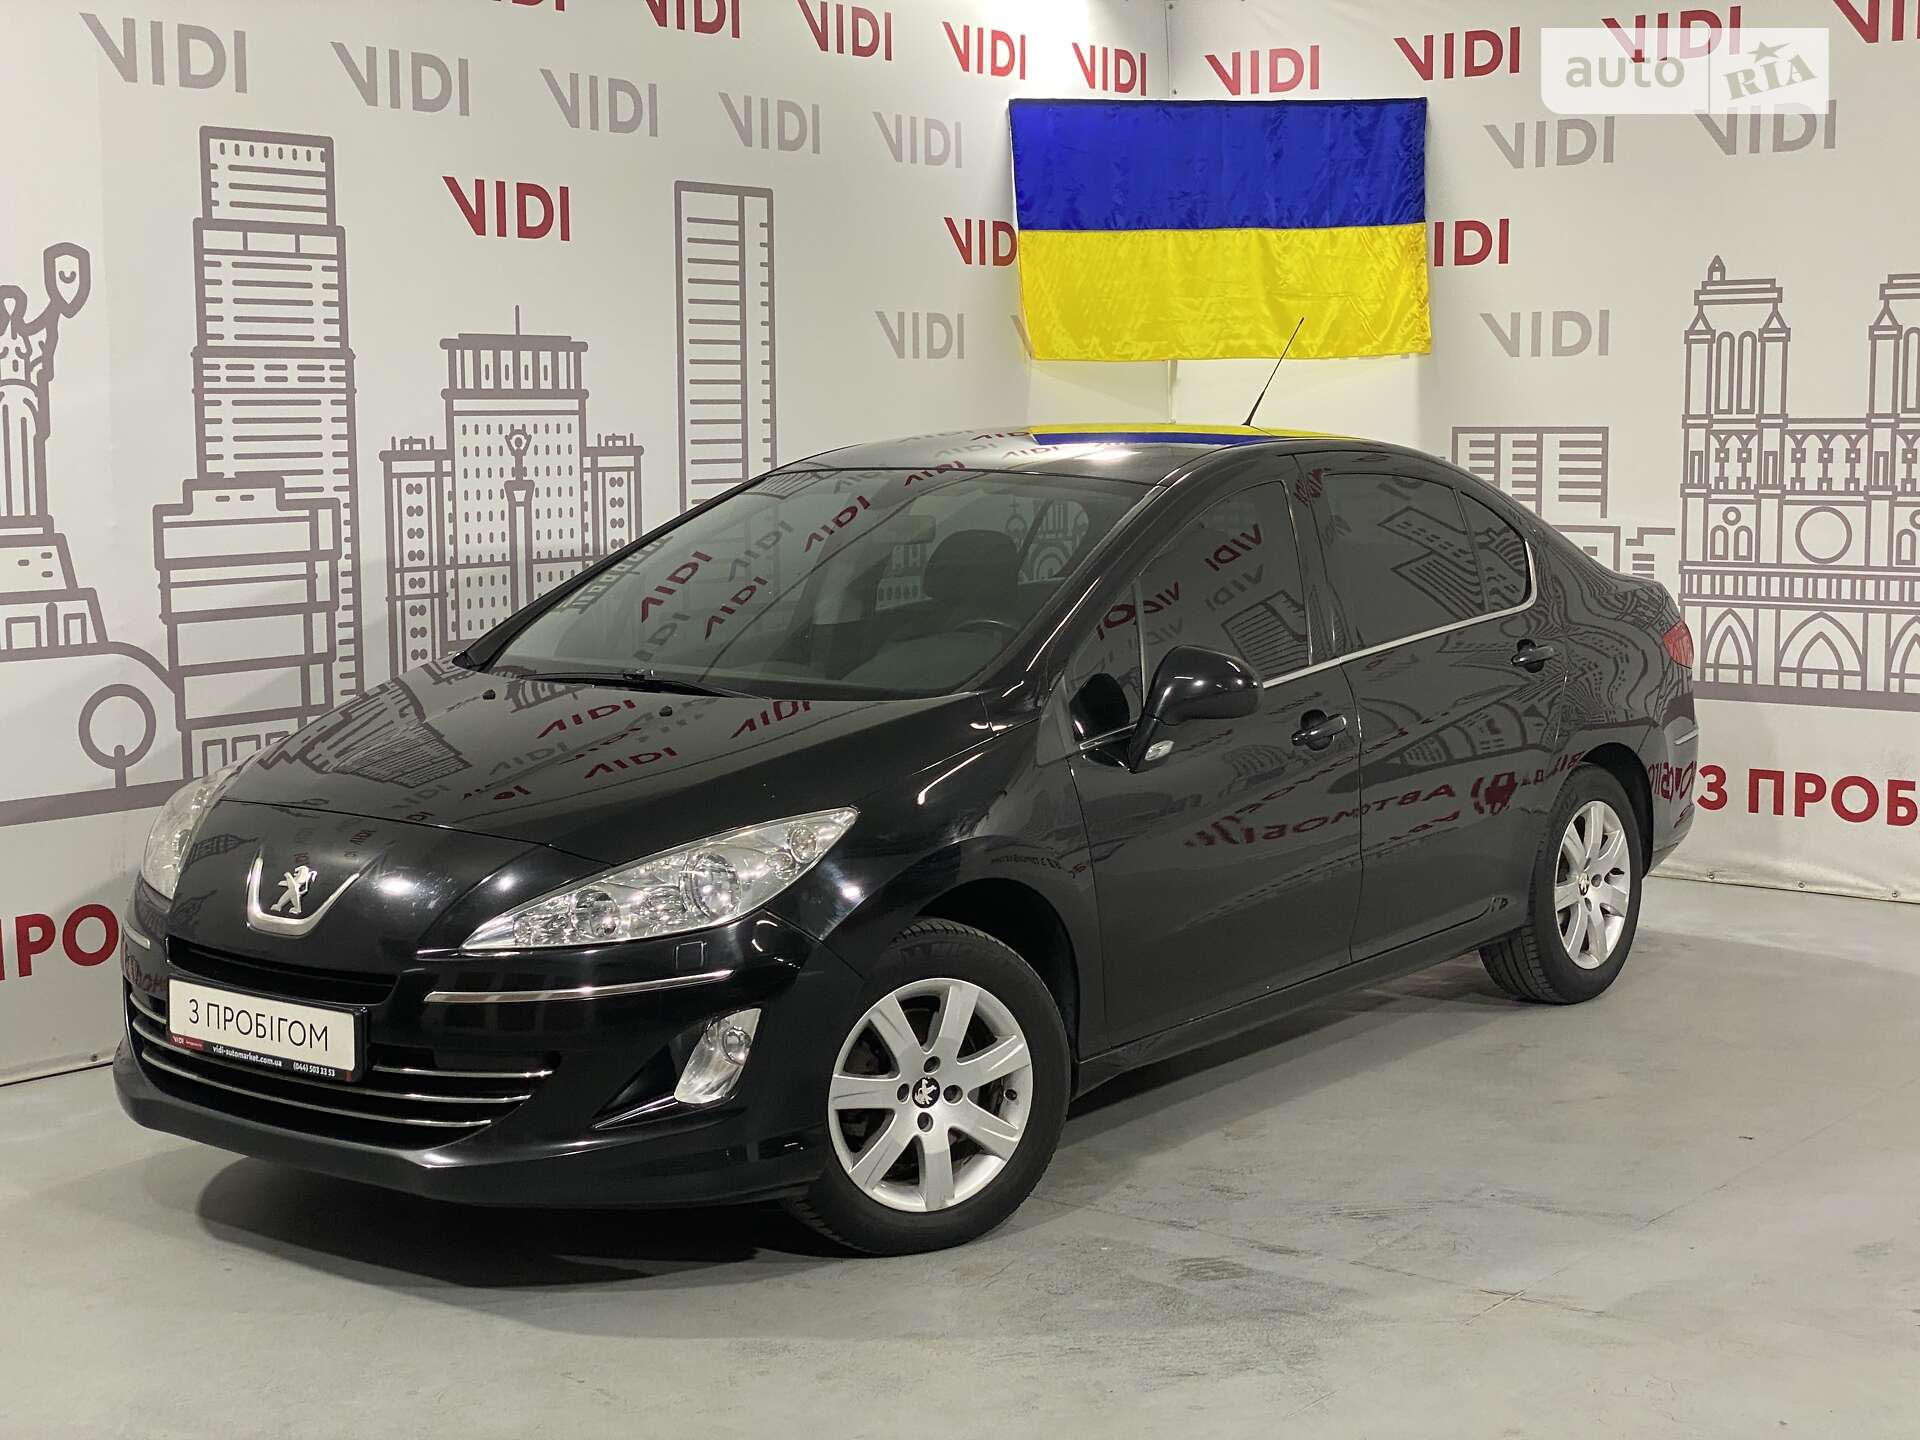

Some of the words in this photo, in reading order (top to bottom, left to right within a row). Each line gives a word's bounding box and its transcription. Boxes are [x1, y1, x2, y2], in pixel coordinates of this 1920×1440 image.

[797, 0, 893, 61] VIDI
[1602, 6, 1742, 64] VIDI
[1833, 0, 1920, 43] VI
[78, 12, 248, 94] VIDI
[943, 21, 1027, 80] VIDI
[1072, 42, 1147, 96] VIDI
[1205, 45, 1321, 96] VIDI
[1394, 26, 1522, 80] VIDI
[329, 41, 470, 116] VIDI
[539, 68, 659, 138] VIDI
[718, 92, 821, 154] VIDI
[872, 111, 962, 168] VIDI
[1483, 116, 1616, 169] VIDI
[1694, 99, 1838, 156] VIDI
[442, 176, 570, 241] VIDI
[944, 217, 1018, 267] VID
[1433, 218, 1511, 267] IDI
[875, 311, 965, 359] VIDI
[1479, 309, 1611, 357] VIDI
[0, 903, 119, 981] РО
[206, 1002, 329, 1052] ПРОБІГОМ
[212, 1045, 283, 1068] vidi-automarket.com.ua
